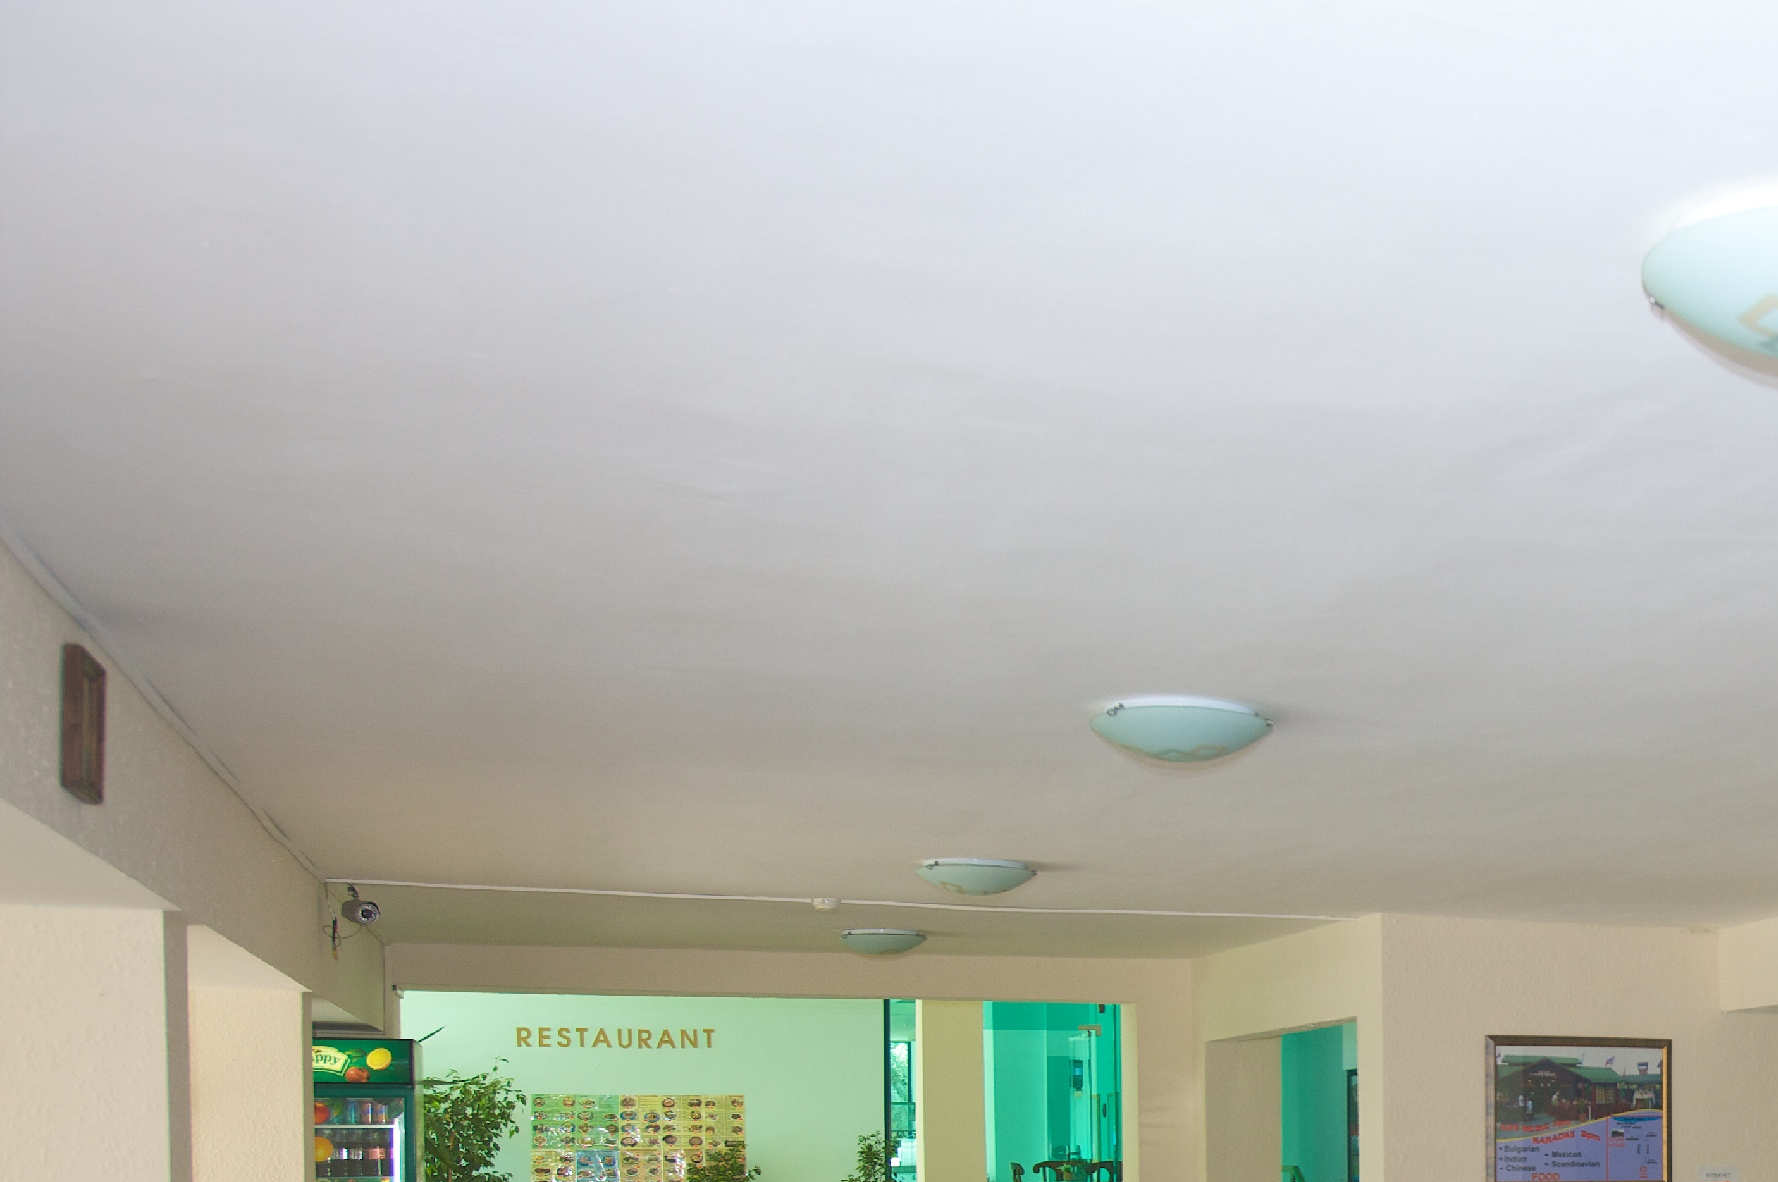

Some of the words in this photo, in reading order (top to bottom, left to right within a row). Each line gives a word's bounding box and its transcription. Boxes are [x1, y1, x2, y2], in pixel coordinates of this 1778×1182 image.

[515, 1026, 716, 1050] RESTAURANT
[1532, 1131, 1575, 1144] KARAOKE
[1504, 1145, 1540, 1154] Bulgarian
[1506, 1164, 1537, 1172] Chinese
[1531, 1172, 1560, 1181] FOOD
